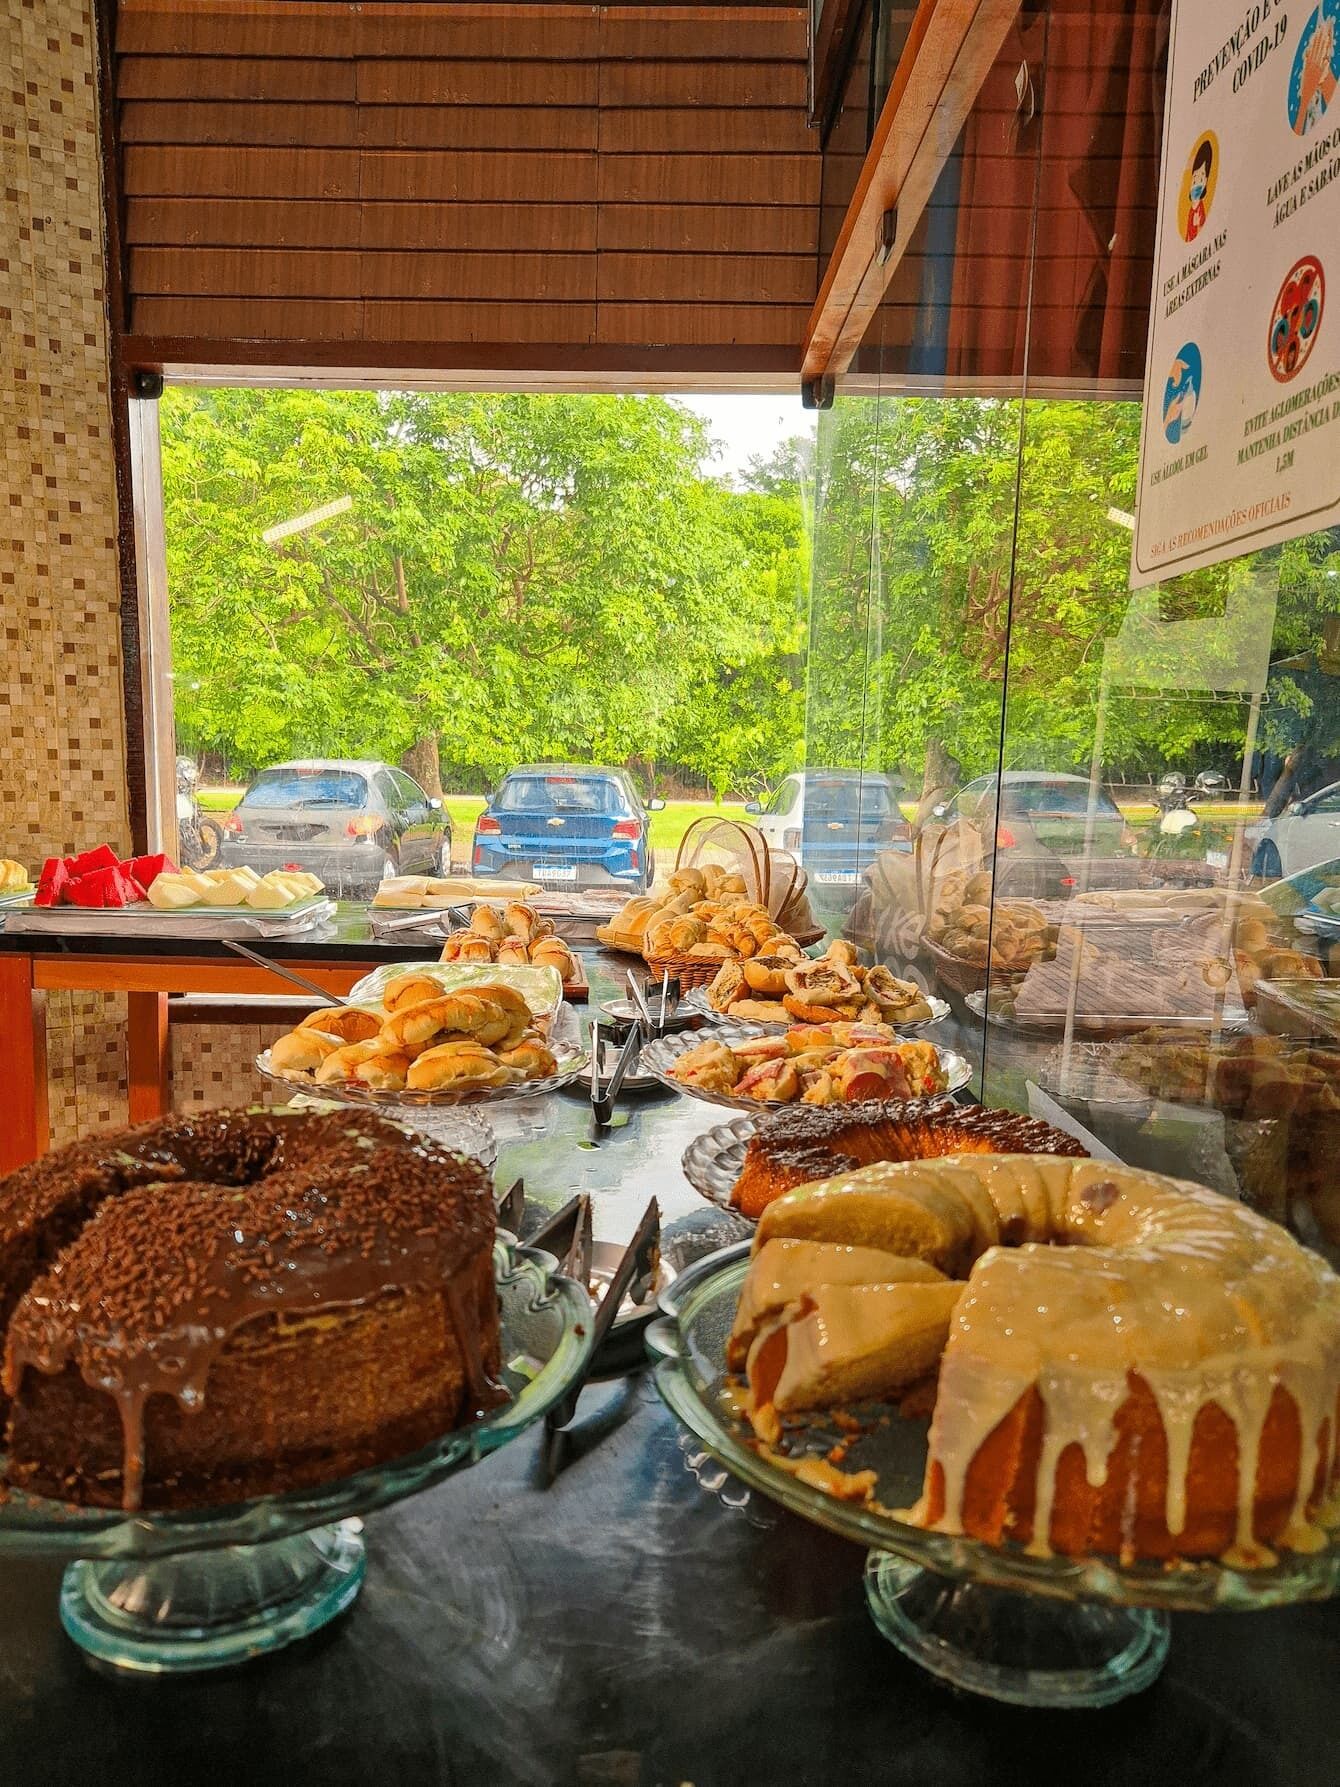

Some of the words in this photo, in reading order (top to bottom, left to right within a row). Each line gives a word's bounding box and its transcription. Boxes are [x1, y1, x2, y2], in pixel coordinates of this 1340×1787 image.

[1193, 6, 1260, 104] PREVENÇÃO
[1232, 14, 1287, 94] COVID-19
[1267, 171, 1290, 206] LAVE
[1291, 160, 1303, 186] AS
[1304, 135, 1331, 174] MÃOS
[1273, 194, 1297, 229] ÁGUA
[1300, 186, 1307, 207] E
[1163, 275, 1175, 296] USE
[1175, 271, 1180, 287] A
[1181, 243, 1212, 282] MÁSCARA
[1212, 229, 1227, 255] NAS
[1164, 289, 1185, 319] ÁREAS
[1186, 259, 1221, 302] EXTERNAS
[1236, 430, 1281, 466] MANTENHA
[1283, 405, 1330, 443] DISTÂNCIA
[1243, 409, 1269, 437] EVITE
[1150, 469, 1161, 487] USE
[1195, 444, 1209, 463] GEL
[1168, 535, 1178, 552] AS
[1178, 508, 1248, 549] RECOMENDAÇÕES
[1248, 491, 1292, 522] OFICIAIS
